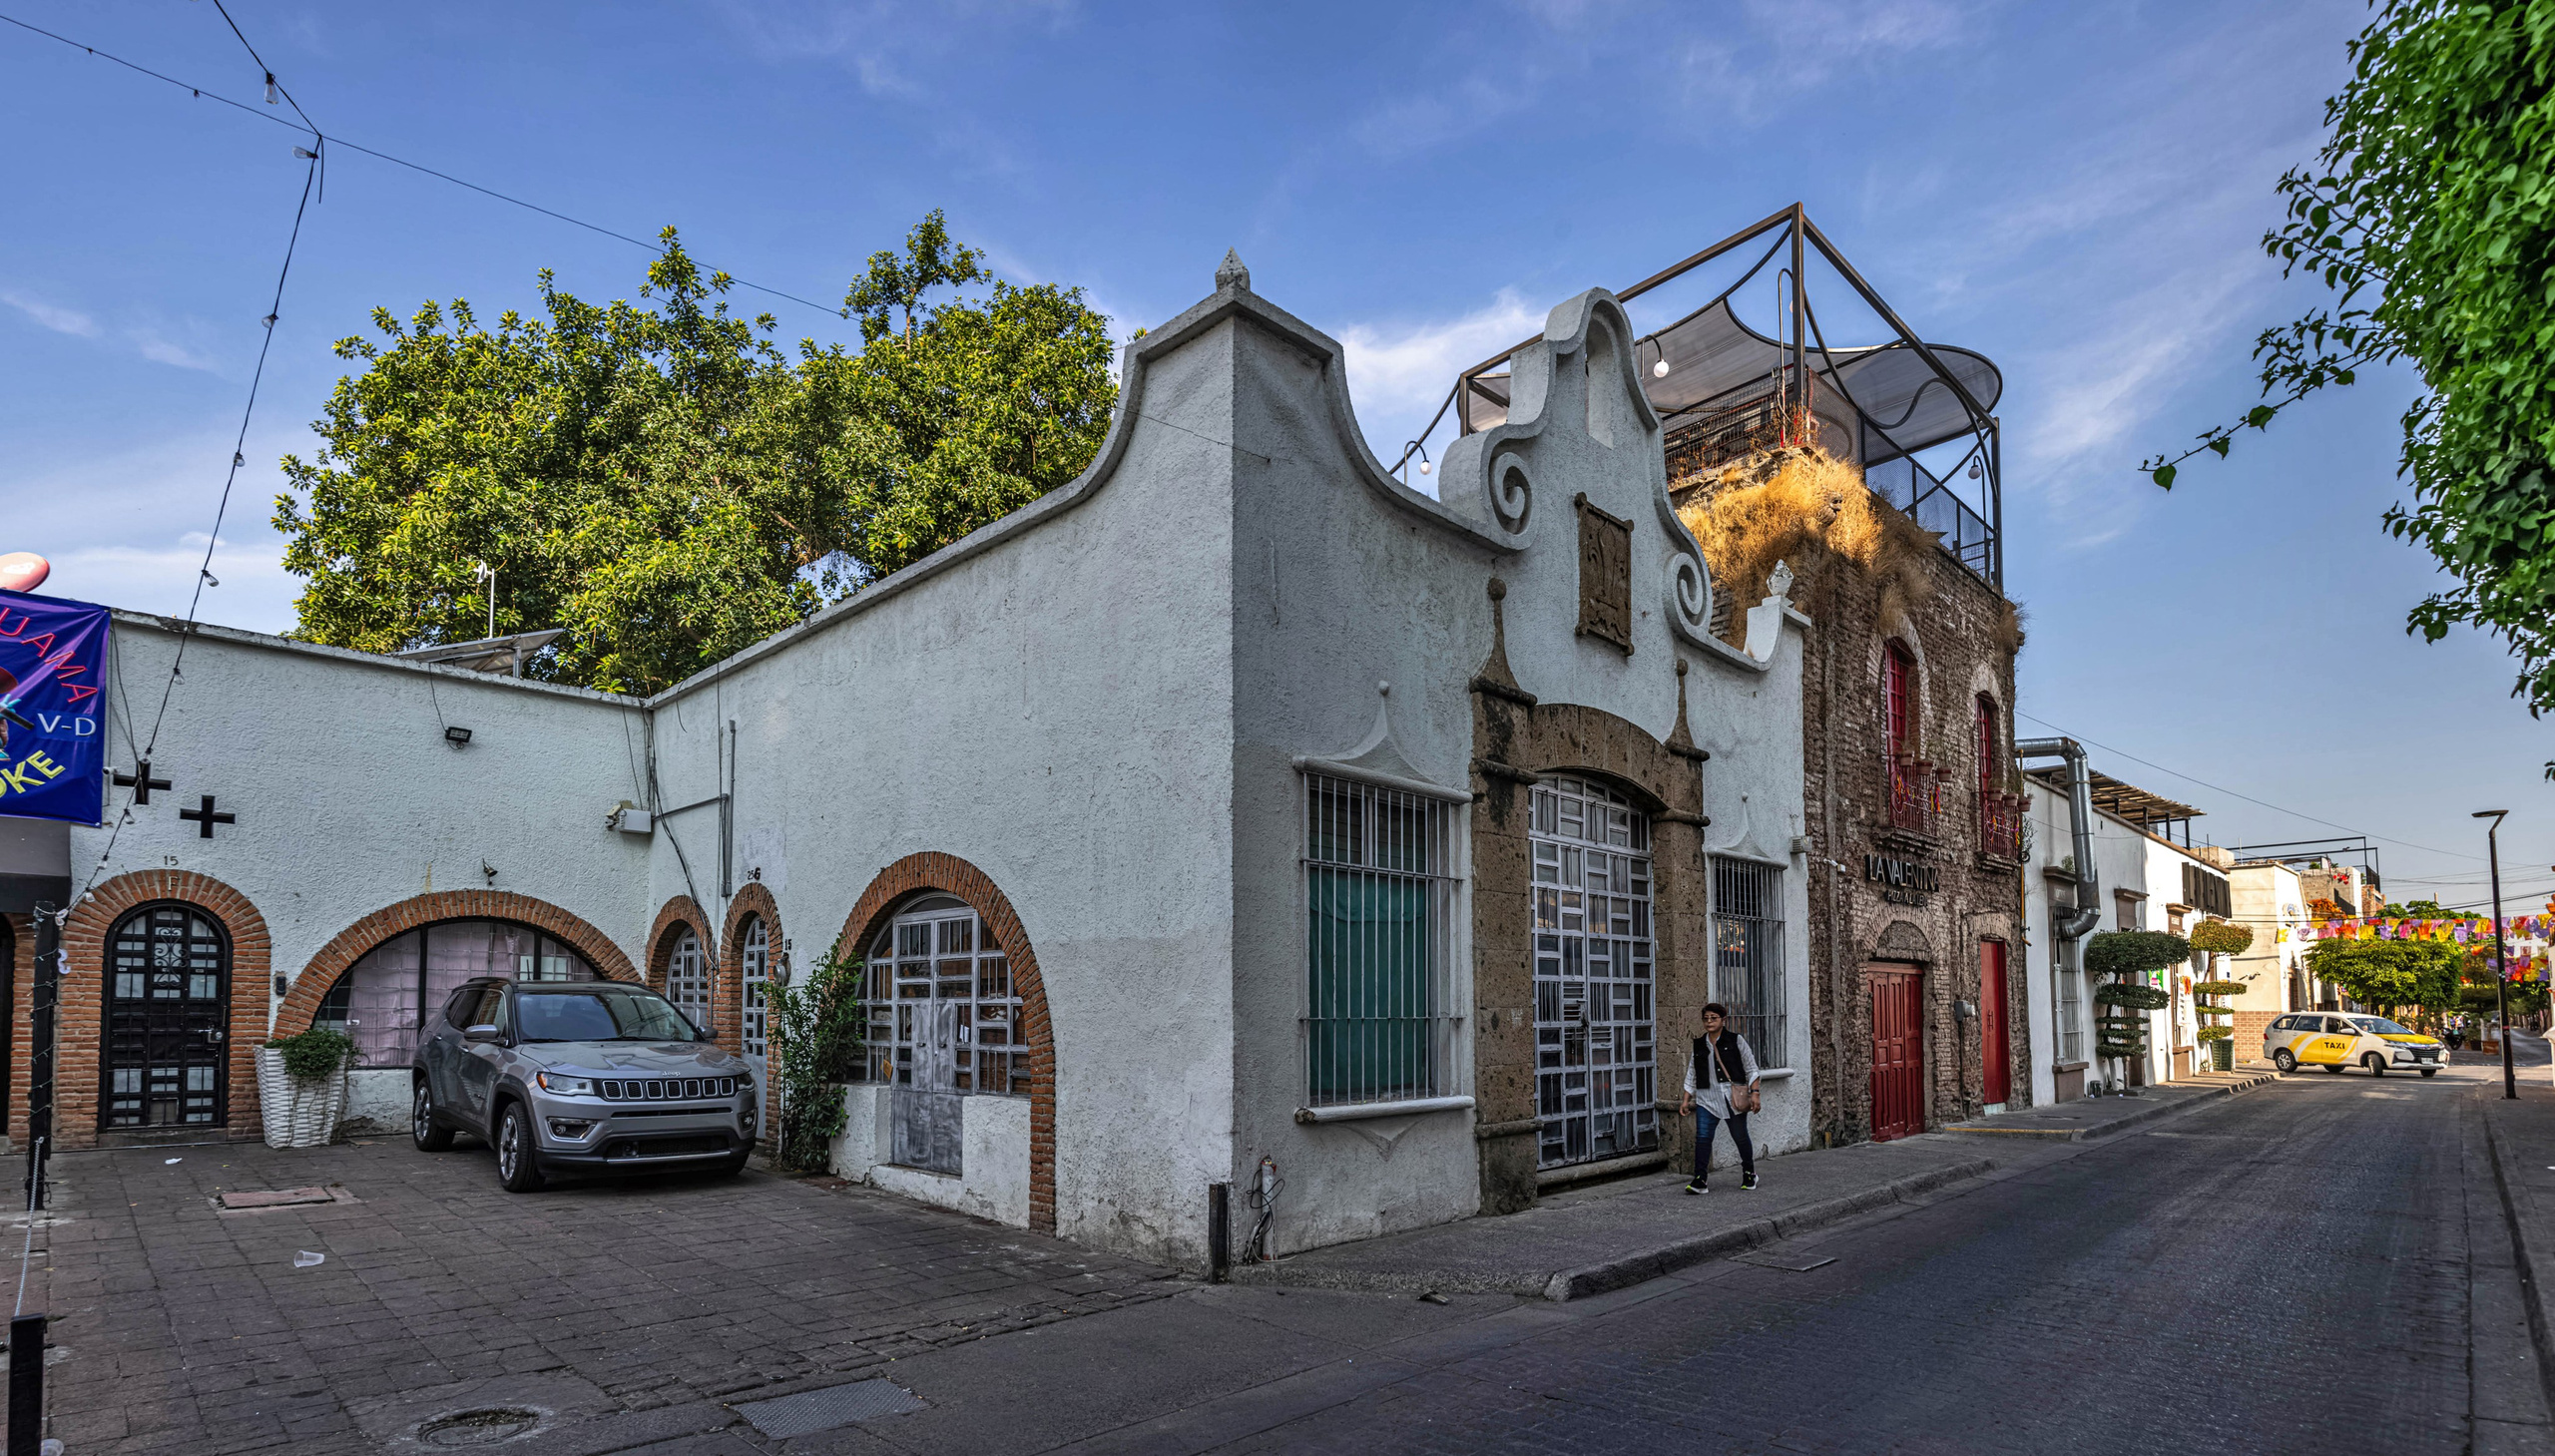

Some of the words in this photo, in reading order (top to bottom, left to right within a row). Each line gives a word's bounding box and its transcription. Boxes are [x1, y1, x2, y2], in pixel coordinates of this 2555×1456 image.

[38, 713, 96, 736] V-D
[164, 855, 179, 866] 15
[1869, 854, 1885, 882] LA
[1885, 857, 1939, 891] VALENTINA
[2323, 1041, 2345, 1050] TAXI
